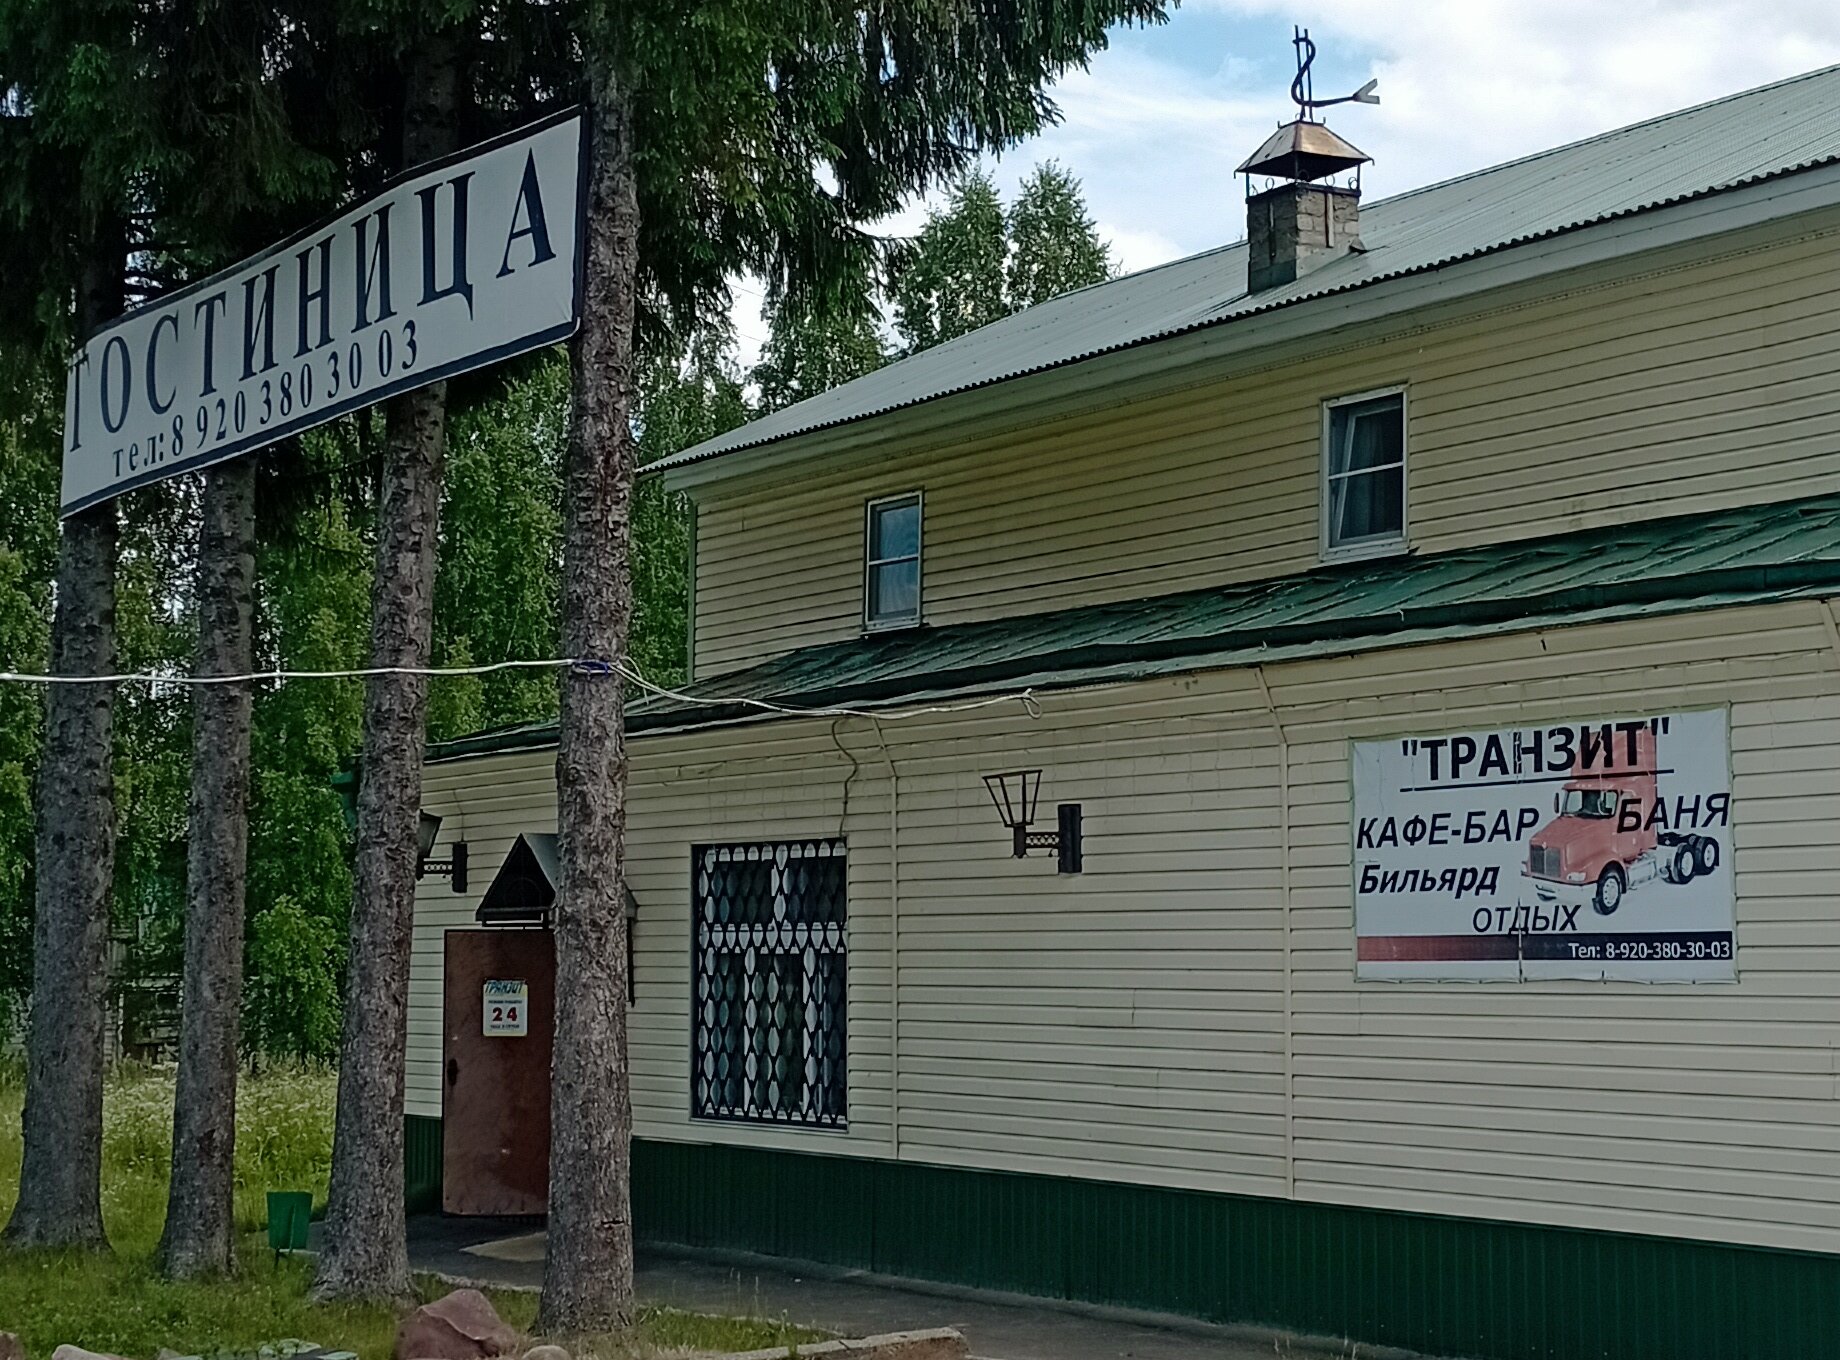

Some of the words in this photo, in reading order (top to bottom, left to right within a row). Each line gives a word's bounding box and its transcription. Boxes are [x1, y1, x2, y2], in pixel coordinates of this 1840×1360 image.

[66, 147, 557, 452] ГОСТИНИЦА
[197, 390, 246, 448] 920
[260, 363, 312, 424] 380
[328, 343, 362, 398] 30
[379, 320, 417, 377] 03
[1402, 717, 1670, 781] "ТРАНЗИТ"
[1356, 808, 1540, 849] КАФЕ-БАР
[1617, 793, 1731, 833] БАНЯ
[1359, 864, 1500, 899] Бильярд
[1568, 943, 1601, 959] Тел:
[1606, 941, 1731, 959] 8-920-380-30-03
[492, 1007, 518, 1022] 24
